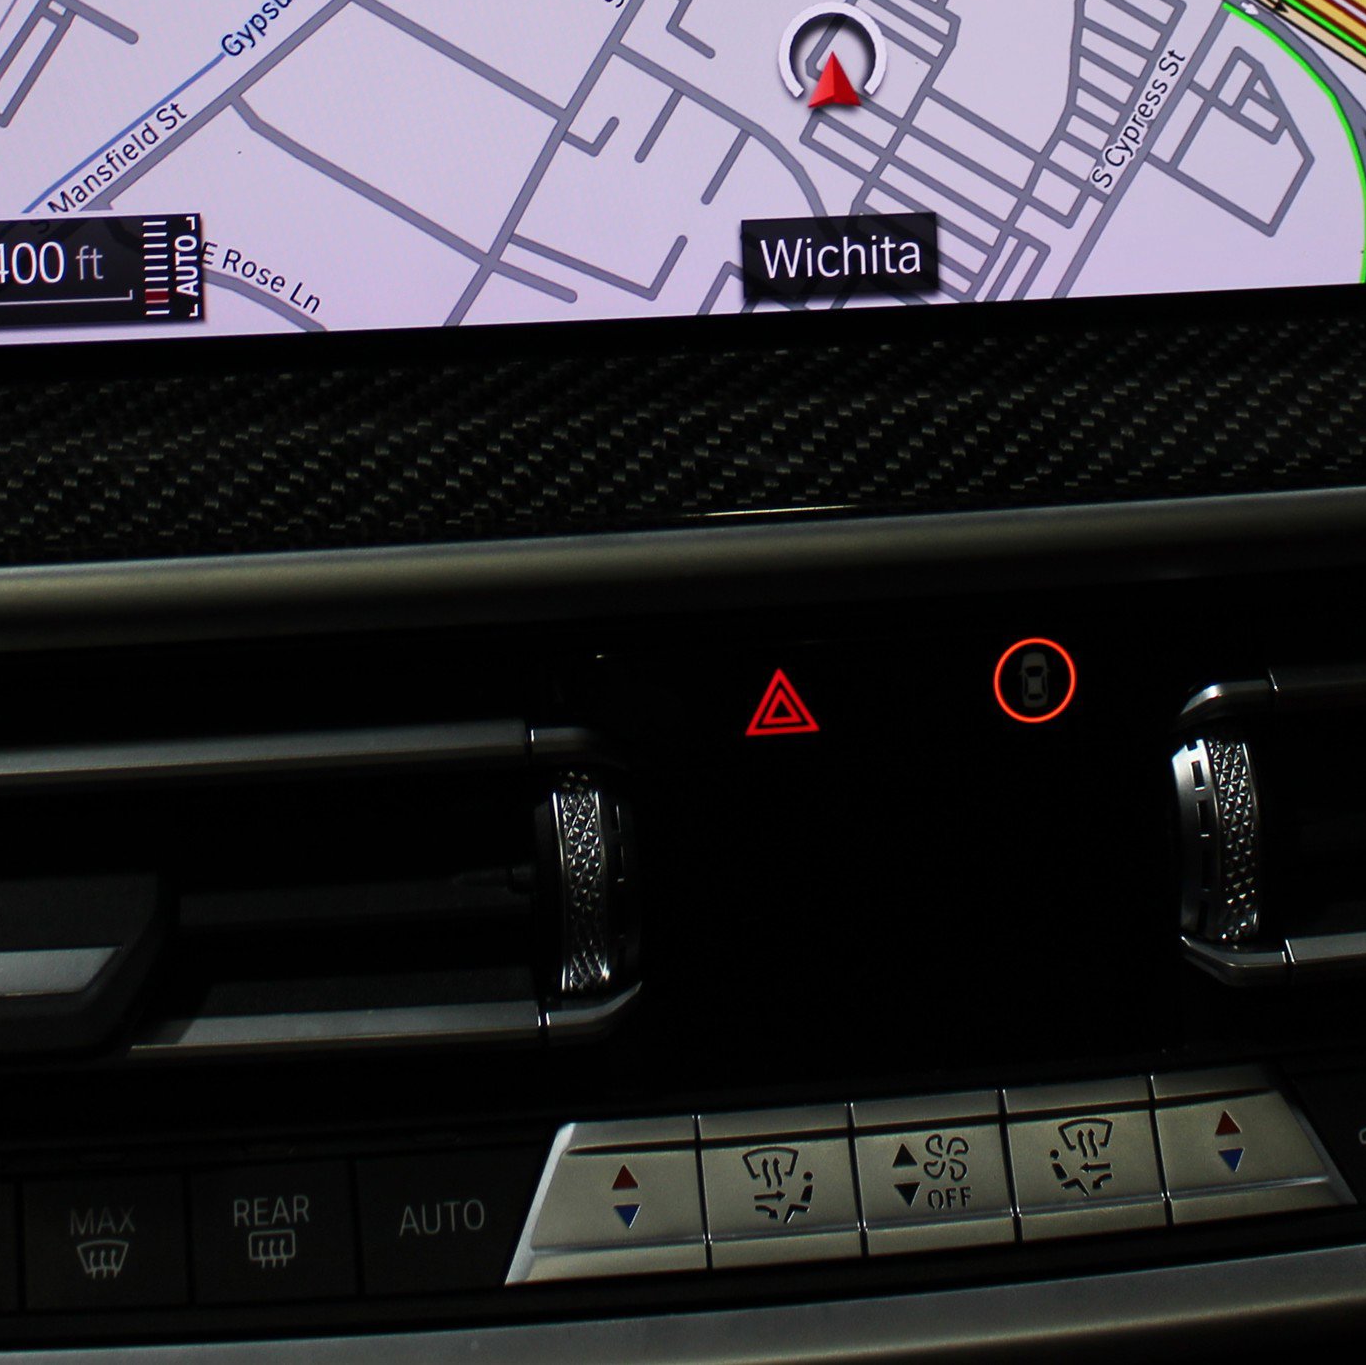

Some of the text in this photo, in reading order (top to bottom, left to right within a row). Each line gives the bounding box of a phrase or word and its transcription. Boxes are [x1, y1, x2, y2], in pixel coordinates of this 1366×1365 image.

[1092, 49, 1186, 189] S Cypress St
[48, 123, 160, 213] Mansfield
[155, 101, 188, 136] St
[75, 245, 104, 280] ft
[174, 234, 199, 297] AUTO
[200, 242, 321, 313] E Rose Ln
[760, 237, 922, 280] Wichita
[234, 1195, 310, 1228] REAR
[398, 1198, 486, 1237] AUTO
[927, 1186, 972, 1211] OFF
[70, 1206, 137, 1235] MAX
